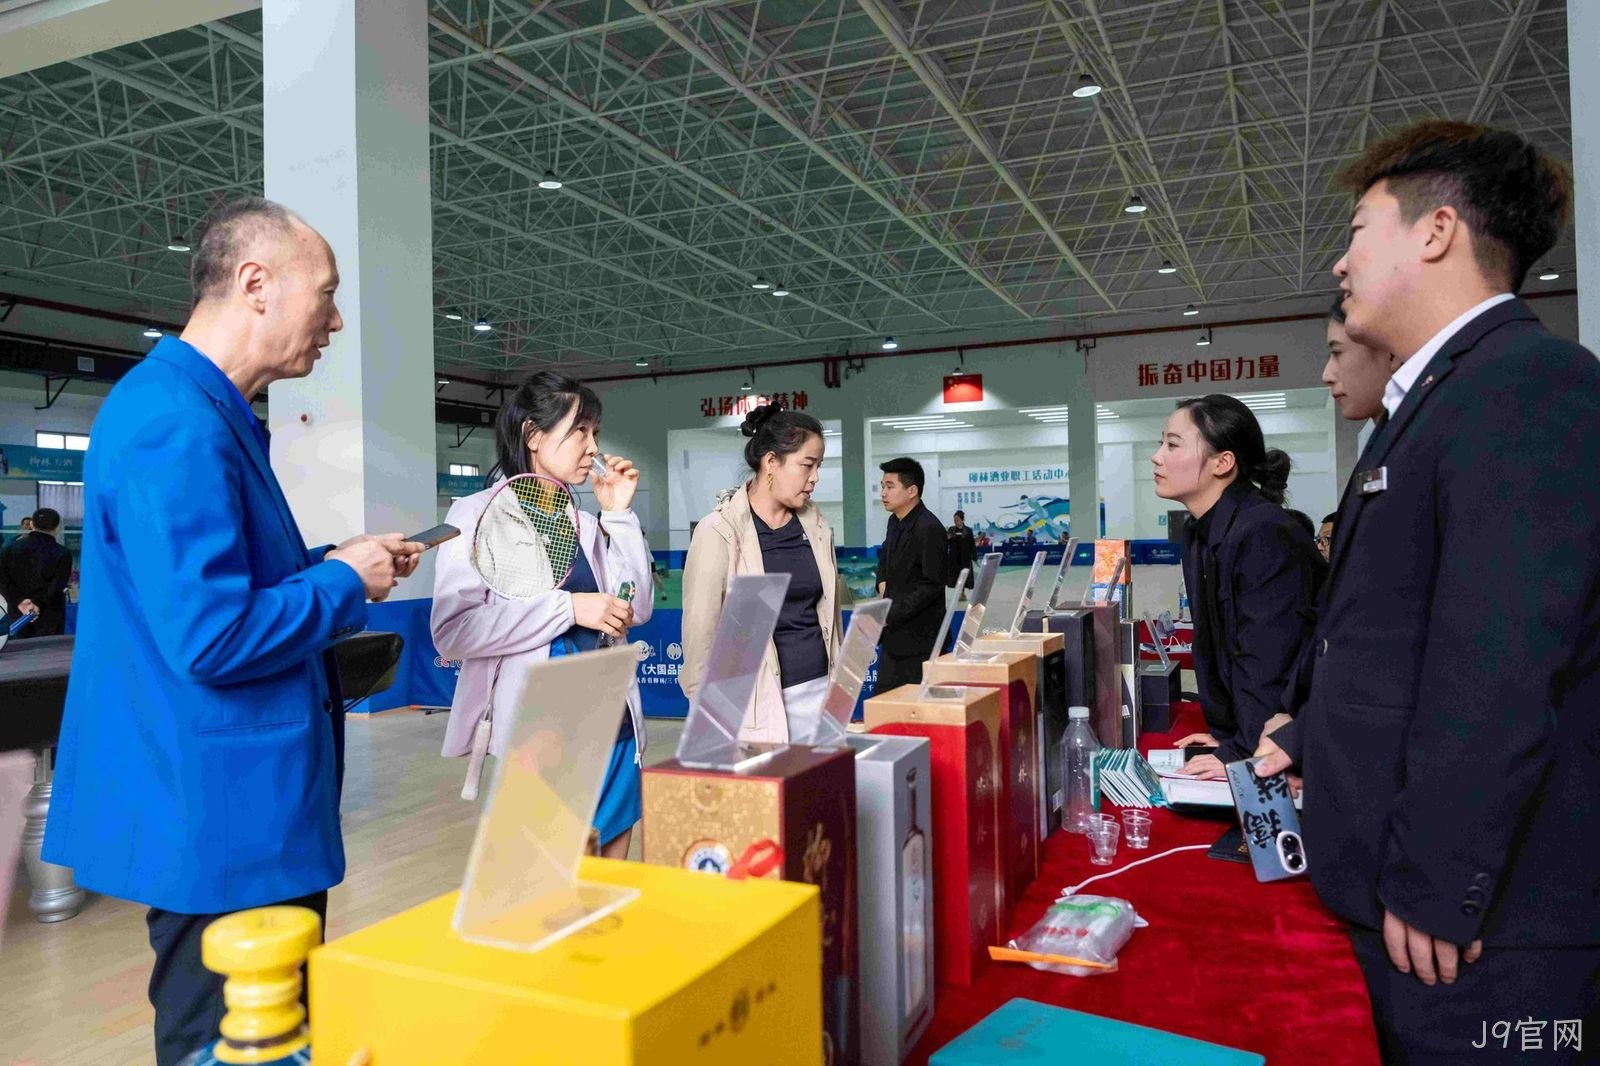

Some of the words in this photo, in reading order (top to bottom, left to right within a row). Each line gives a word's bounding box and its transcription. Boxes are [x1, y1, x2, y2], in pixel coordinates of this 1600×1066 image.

[1138, 355, 1280, 387] 振奋中国力量
